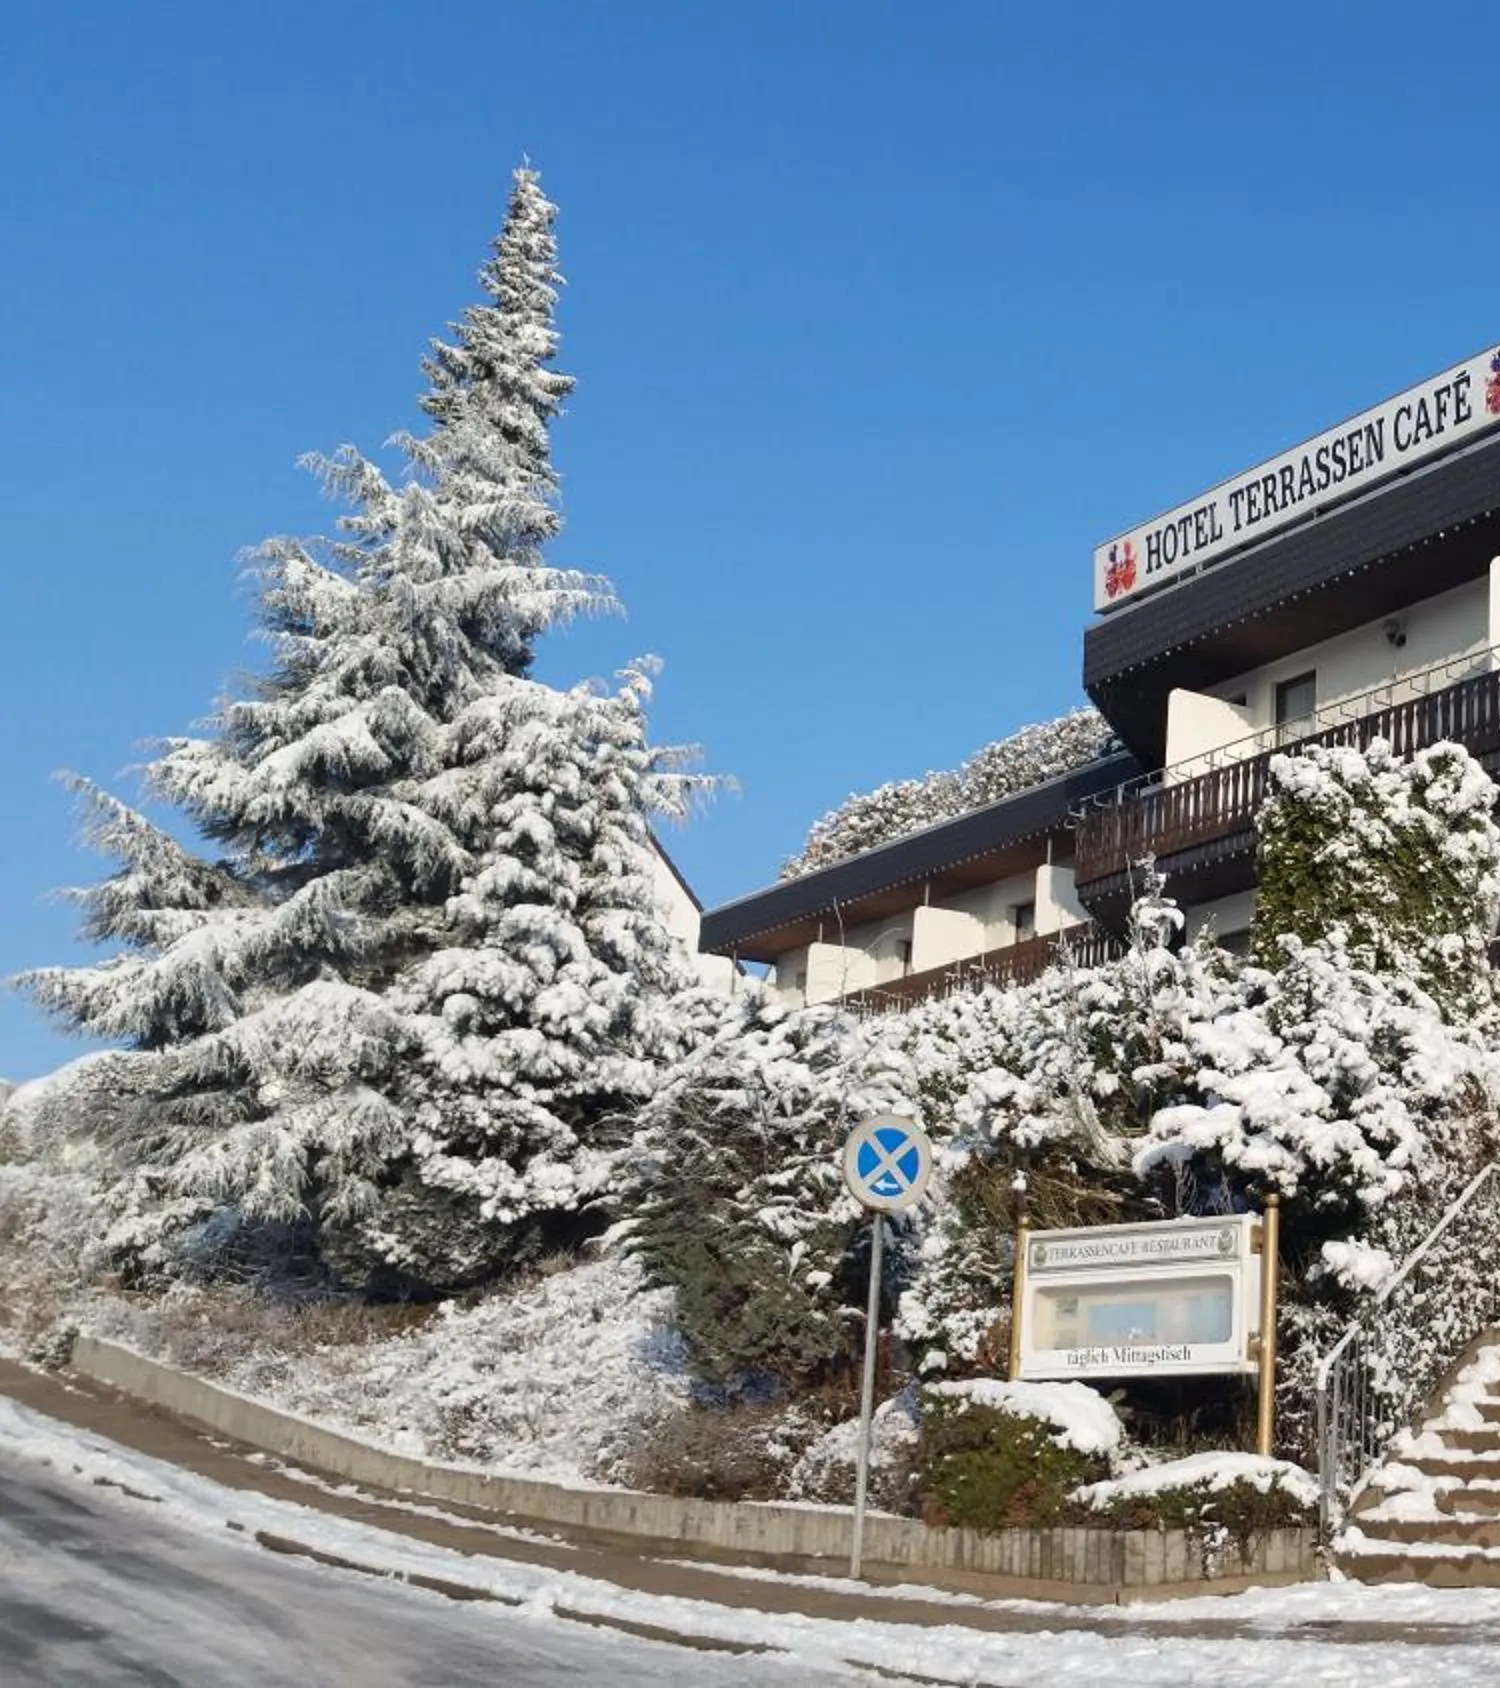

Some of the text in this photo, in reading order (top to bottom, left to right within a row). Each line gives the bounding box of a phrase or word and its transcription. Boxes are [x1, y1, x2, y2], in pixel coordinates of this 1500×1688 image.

[1145, 370, 1472, 574] HOTEL TERRASSEN CAFÉ
